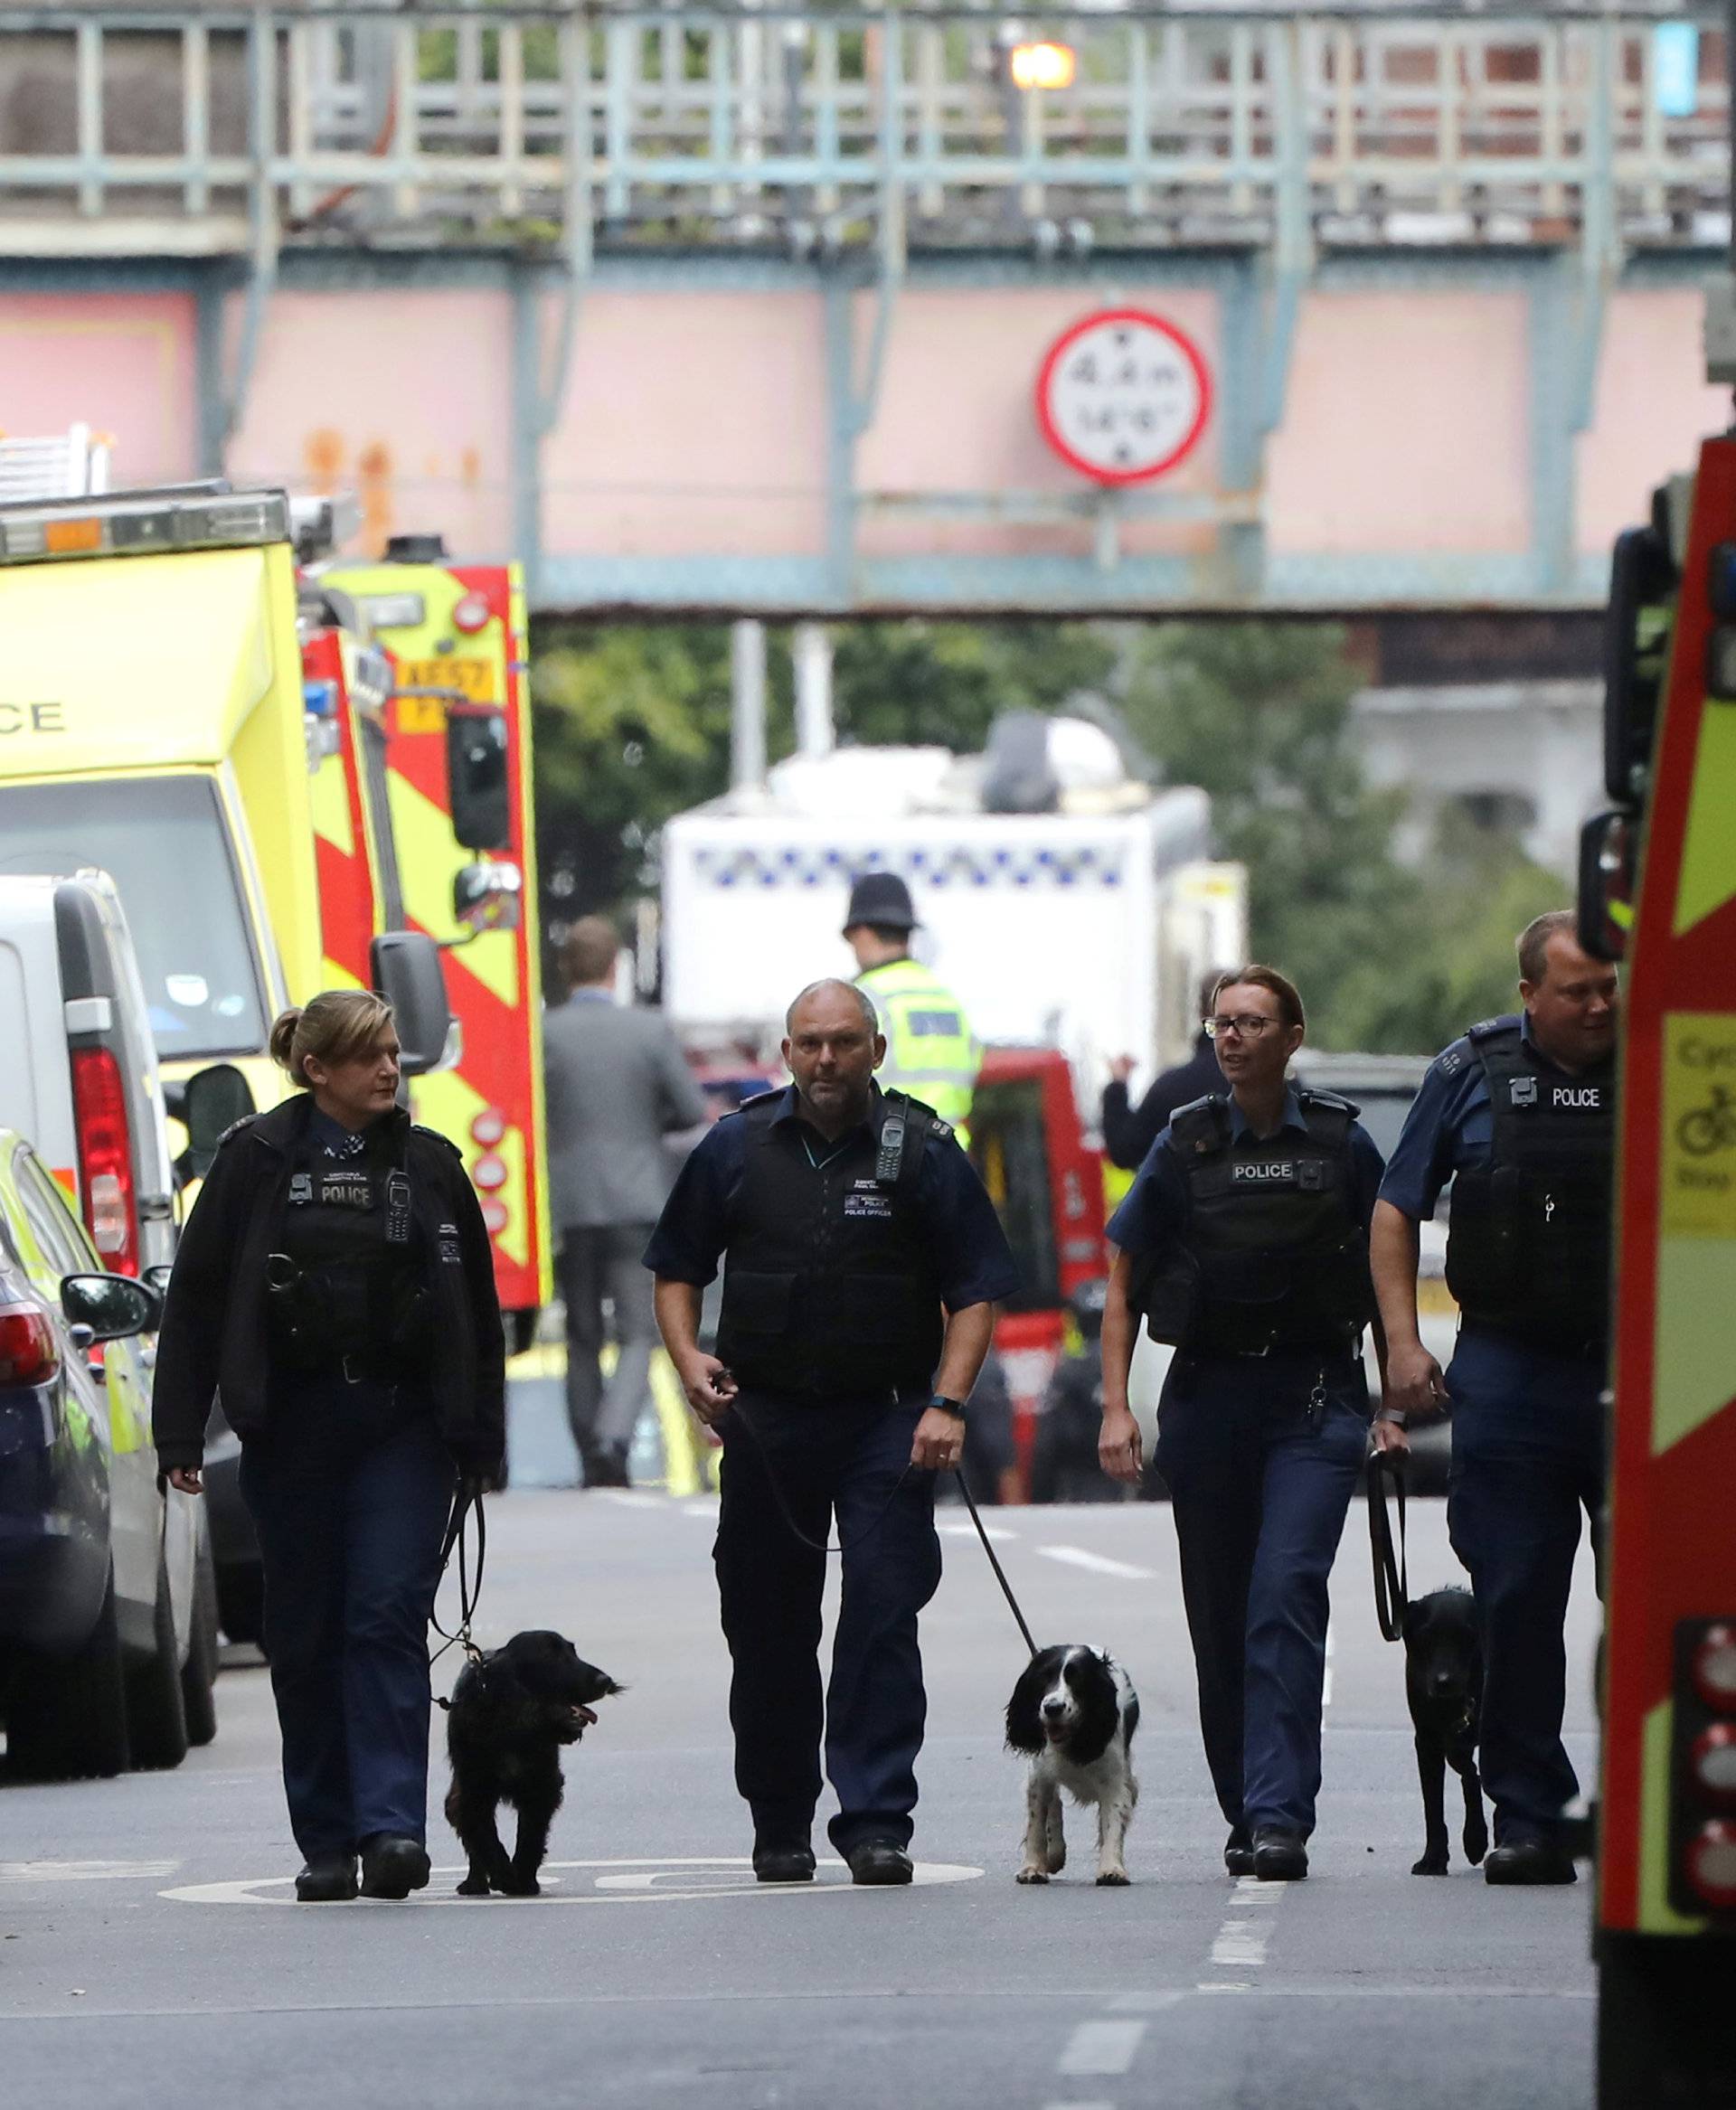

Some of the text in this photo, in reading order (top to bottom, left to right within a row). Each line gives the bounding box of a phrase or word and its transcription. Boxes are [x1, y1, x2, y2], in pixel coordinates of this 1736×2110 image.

[1552, 1088, 1600, 1107] POLICE
[1235, 1163, 1292, 1179] POLICE
[322, 1185, 371, 1207] POLICE
